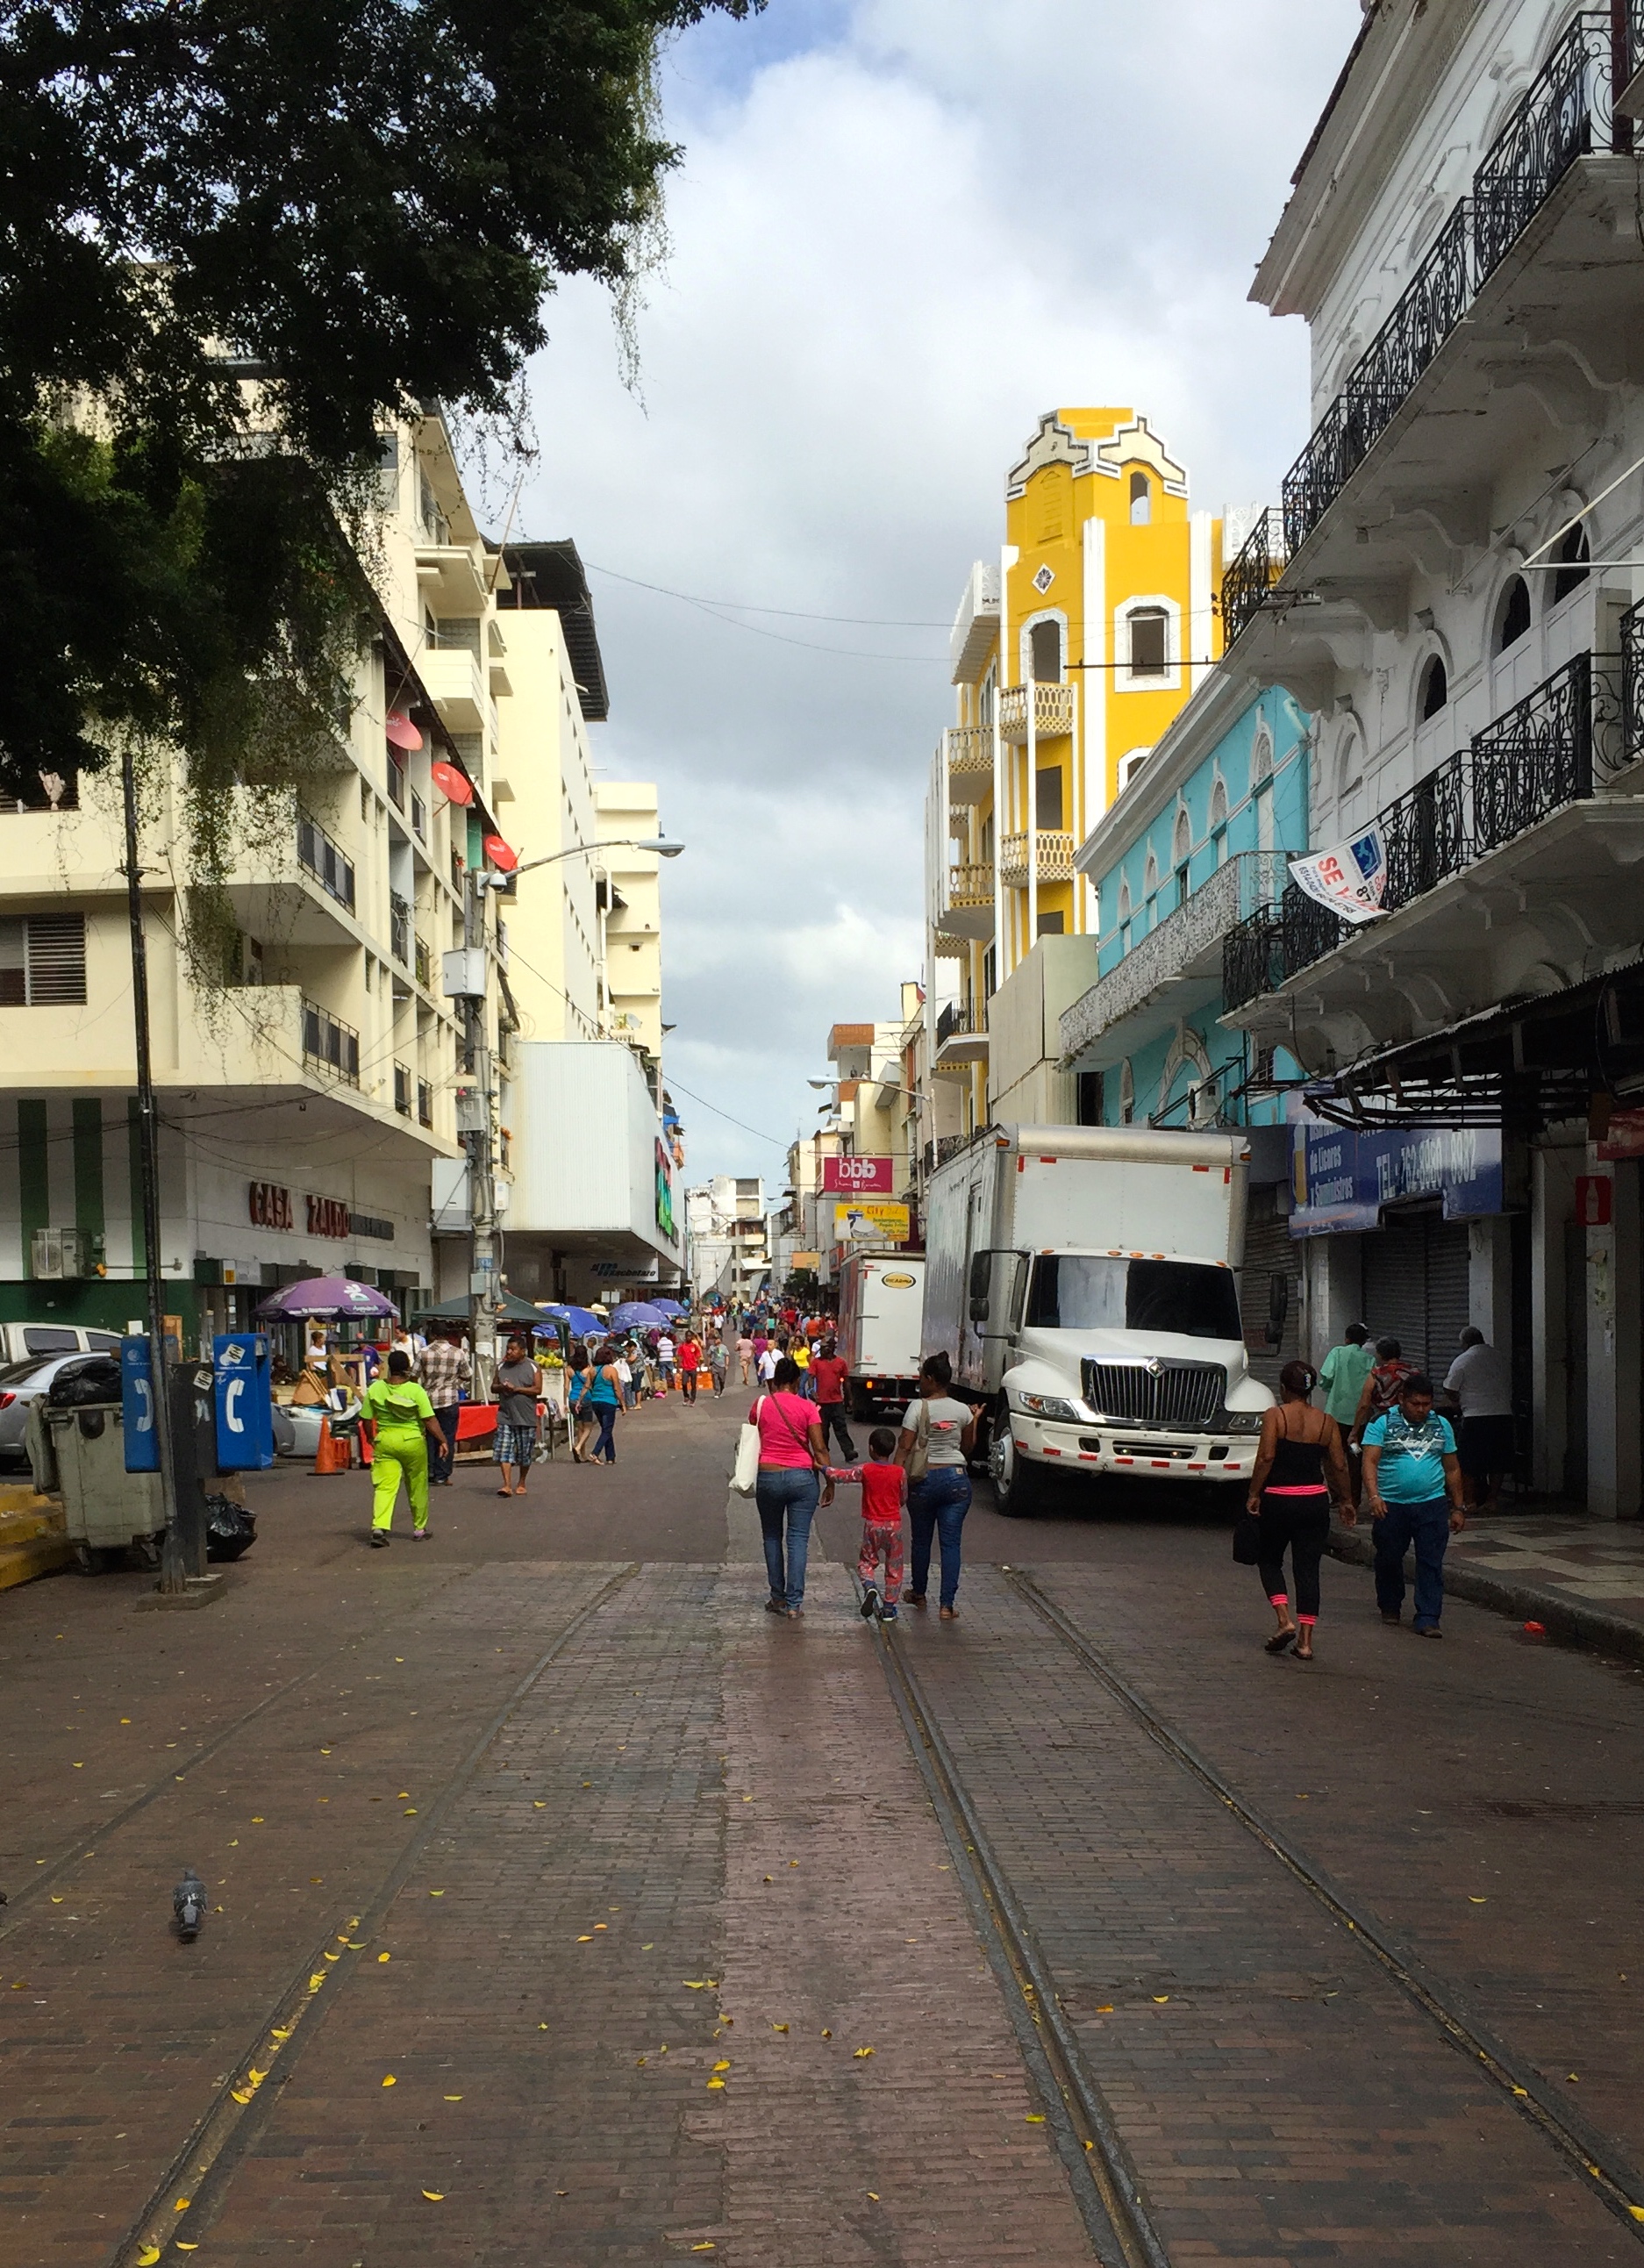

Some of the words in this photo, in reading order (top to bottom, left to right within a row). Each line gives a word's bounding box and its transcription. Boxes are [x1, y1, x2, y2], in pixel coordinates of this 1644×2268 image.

[1318, 856, 1345, 886] SE
[839, 1158, 876, 1179] bbb
[1310, 1149, 1318, 1176] de
[1318, 1144, 1342, 1173] Licores
[249, 1181, 295, 1232] CASA
[305, 1194, 350, 1240] ZALDO
